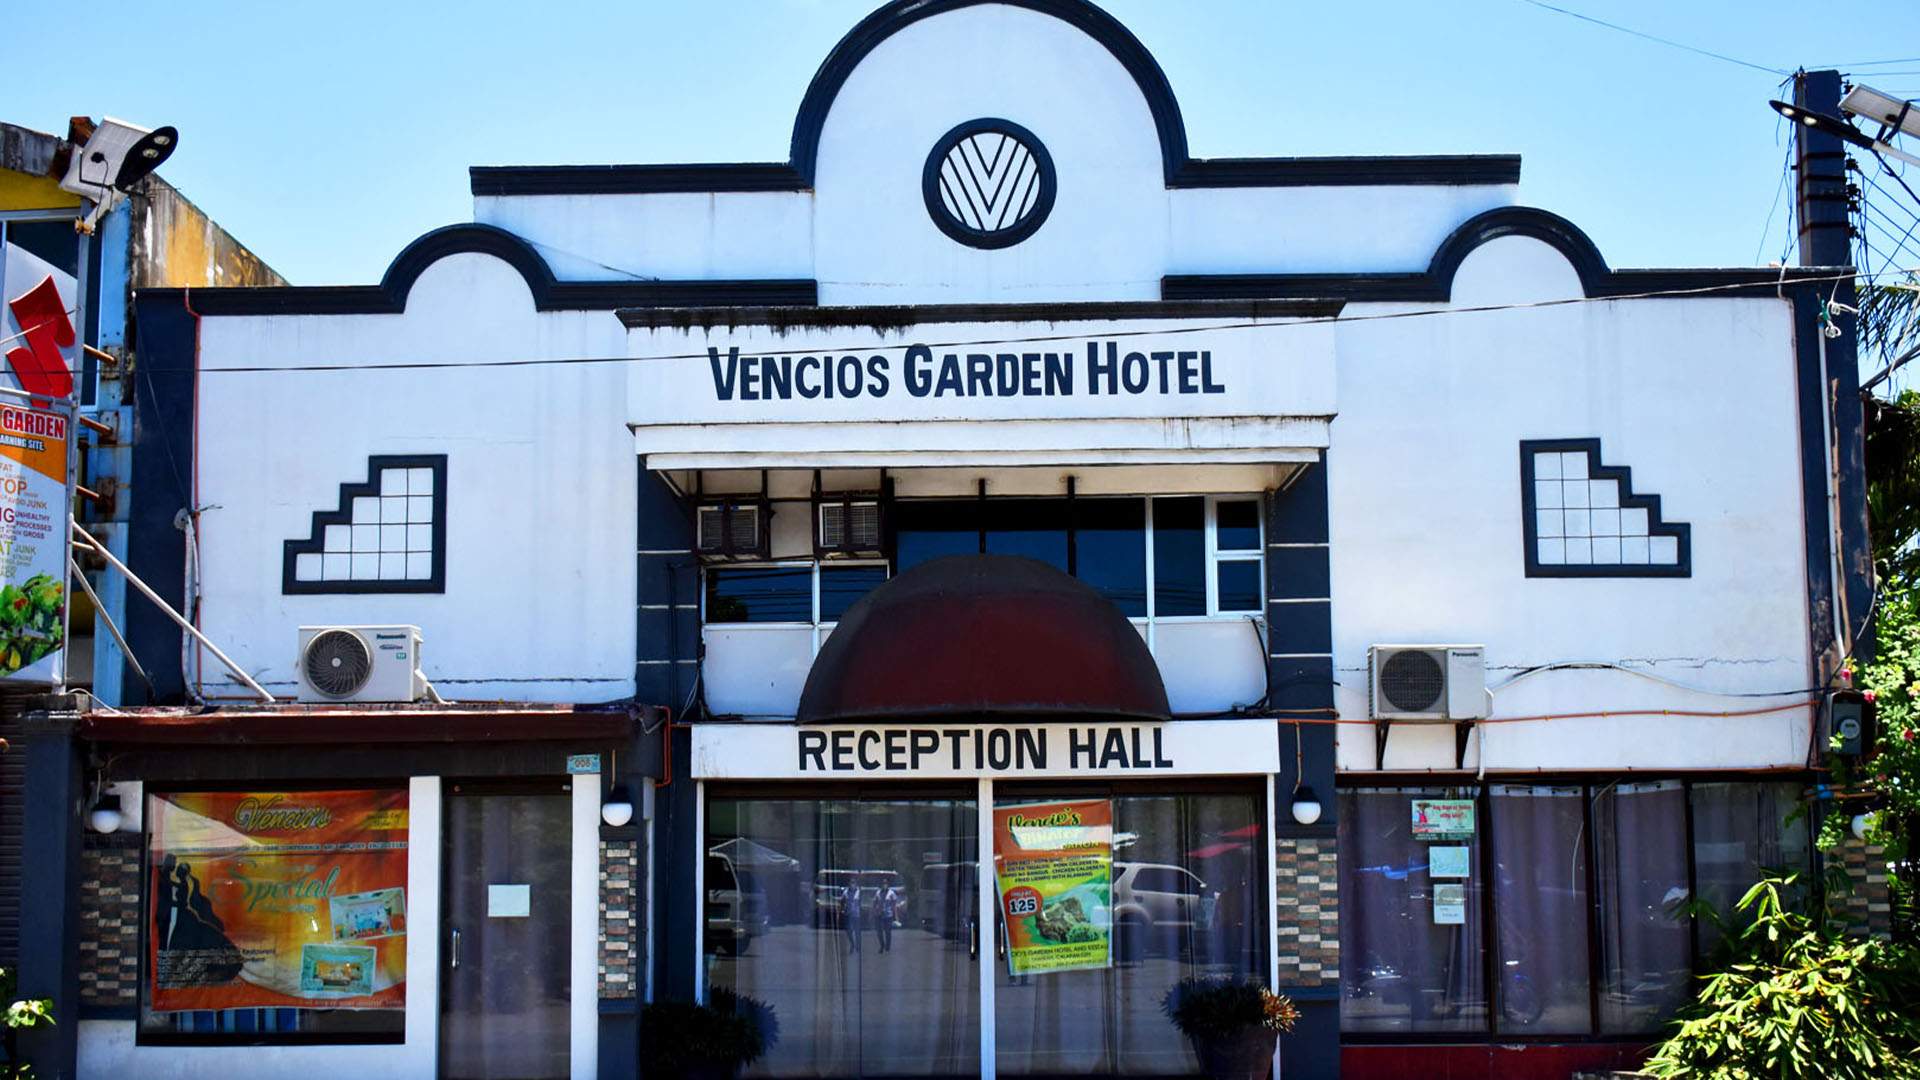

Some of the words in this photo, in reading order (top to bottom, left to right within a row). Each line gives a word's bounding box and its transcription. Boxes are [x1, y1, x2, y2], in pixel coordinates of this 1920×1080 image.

[708, 346, 890, 400] VENCIOS
[904, 344, 1073, 397] GARDEN
[1087, 341, 1225, 394] HOTEL
[3, 409, 64, 439] GARDEN
[799, 728, 1046, 770] RECEPTION
[1069, 727, 1173, 769] HALL
[1009, 898, 1036, 913] 125
